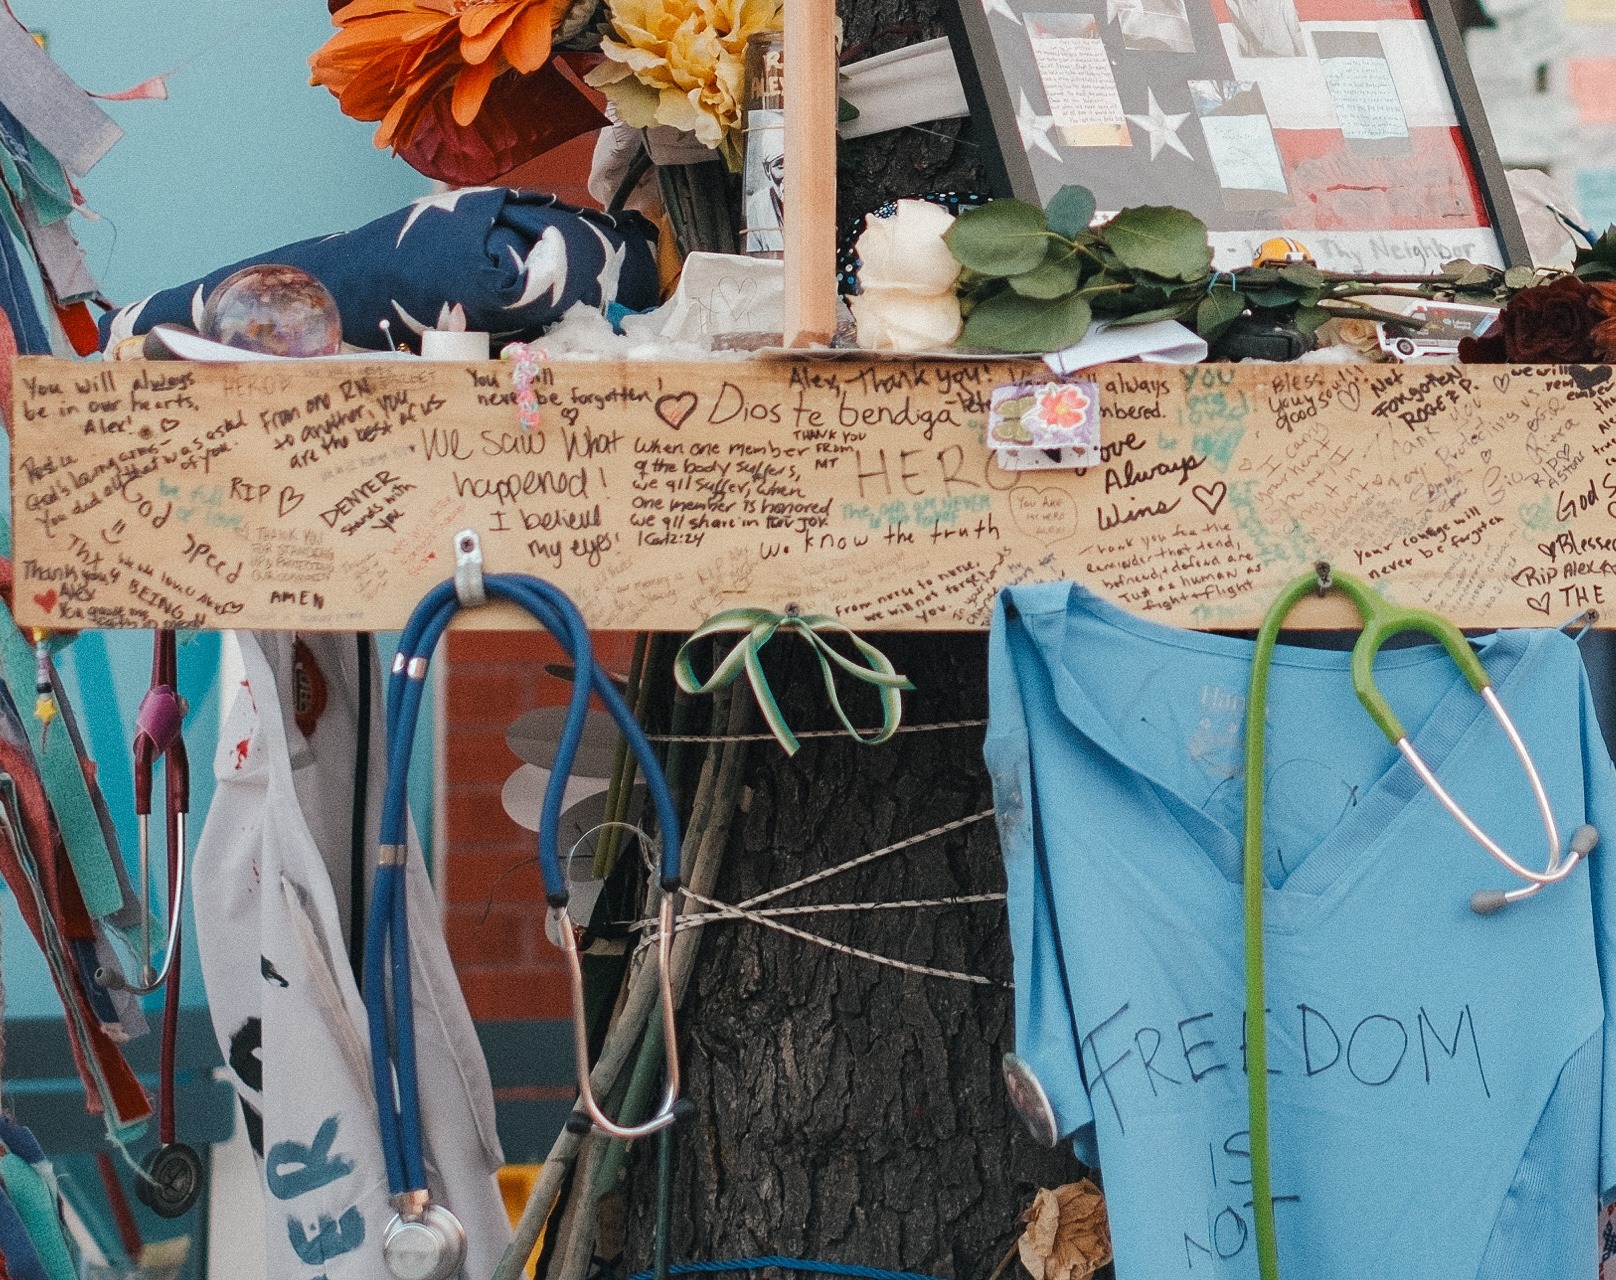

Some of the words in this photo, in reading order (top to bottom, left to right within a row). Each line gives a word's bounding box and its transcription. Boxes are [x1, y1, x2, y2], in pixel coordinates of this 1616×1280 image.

[1369, 235, 1477, 268] Neighbor
[467, 368, 500, 388] You
[1511, 367, 1533, 377] we
[22, 376, 62, 399] You
[75, 370, 116, 394] will
[133, 370, 196, 392] always
[340, 376, 374, 402] RN
[1105, 372, 1171, 399] always
[534, 390, 563, 406] be
[23, 401, 48, 421] be
[60, 401, 79, 417] in
[89, 399, 122, 413] our
[708, 381, 781, 425] Dios
[793, 389, 825, 427] te
[839, 390, 961, 441] bendiga
[1276, 405, 1317, 433] good
[274, 433, 294, 451] to
[421, 428, 475, 462] We
[794, 429, 837, 441] THANK
[290, 448, 320, 469] are
[689, 440, 720, 456] one
[730, 440, 810, 458] member
[651, 458, 679, 474] the
[684, 459, 731, 477] body
[856, 444, 1021, 497] HERO
[1105, 455, 1207, 494] Always
[1525, 457, 1558, 487] RIP
[230, 476, 271, 504] RIP
[632, 478, 658, 491] we
[666, 475, 691, 492] all
[761, 497, 833, 515] honored
[1557, 478, 1599, 521] God
[489, 511, 511, 532] I
[629, 514, 656, 527] we
[662, 514, 685, 530] all
[689, 514, 736, 530] share
[742, 518, 759, 527] in
[1097, 496, 1181, 531] Wins
[1454, 505, 1482, 524] will
[804, 530, 868, 553] know
[884, 520, 915, 547] the
[931, 512, 999, 545] truth
[1142, 534, 1167, 550] you
[1202, 522, 1231, 533] the
[528, 538, 562, 569] my
[1154, 545, 1191, 561] that
[1227, 551, 1254, 563] are
[1369, 558, 1413, 580] never
[1419, 545, 1445, 559] be
[23, 559, 79, 582] Thank
[917, 578, 934, 591] to
[1159, 583, 1175, 593] as
[1559, 583, 1605, 607] THE
[271, 590, 324, 609] AMEN
[864, 610, 884, 623] we
[1078, 1002, 1491, 1135] FREEDOM
